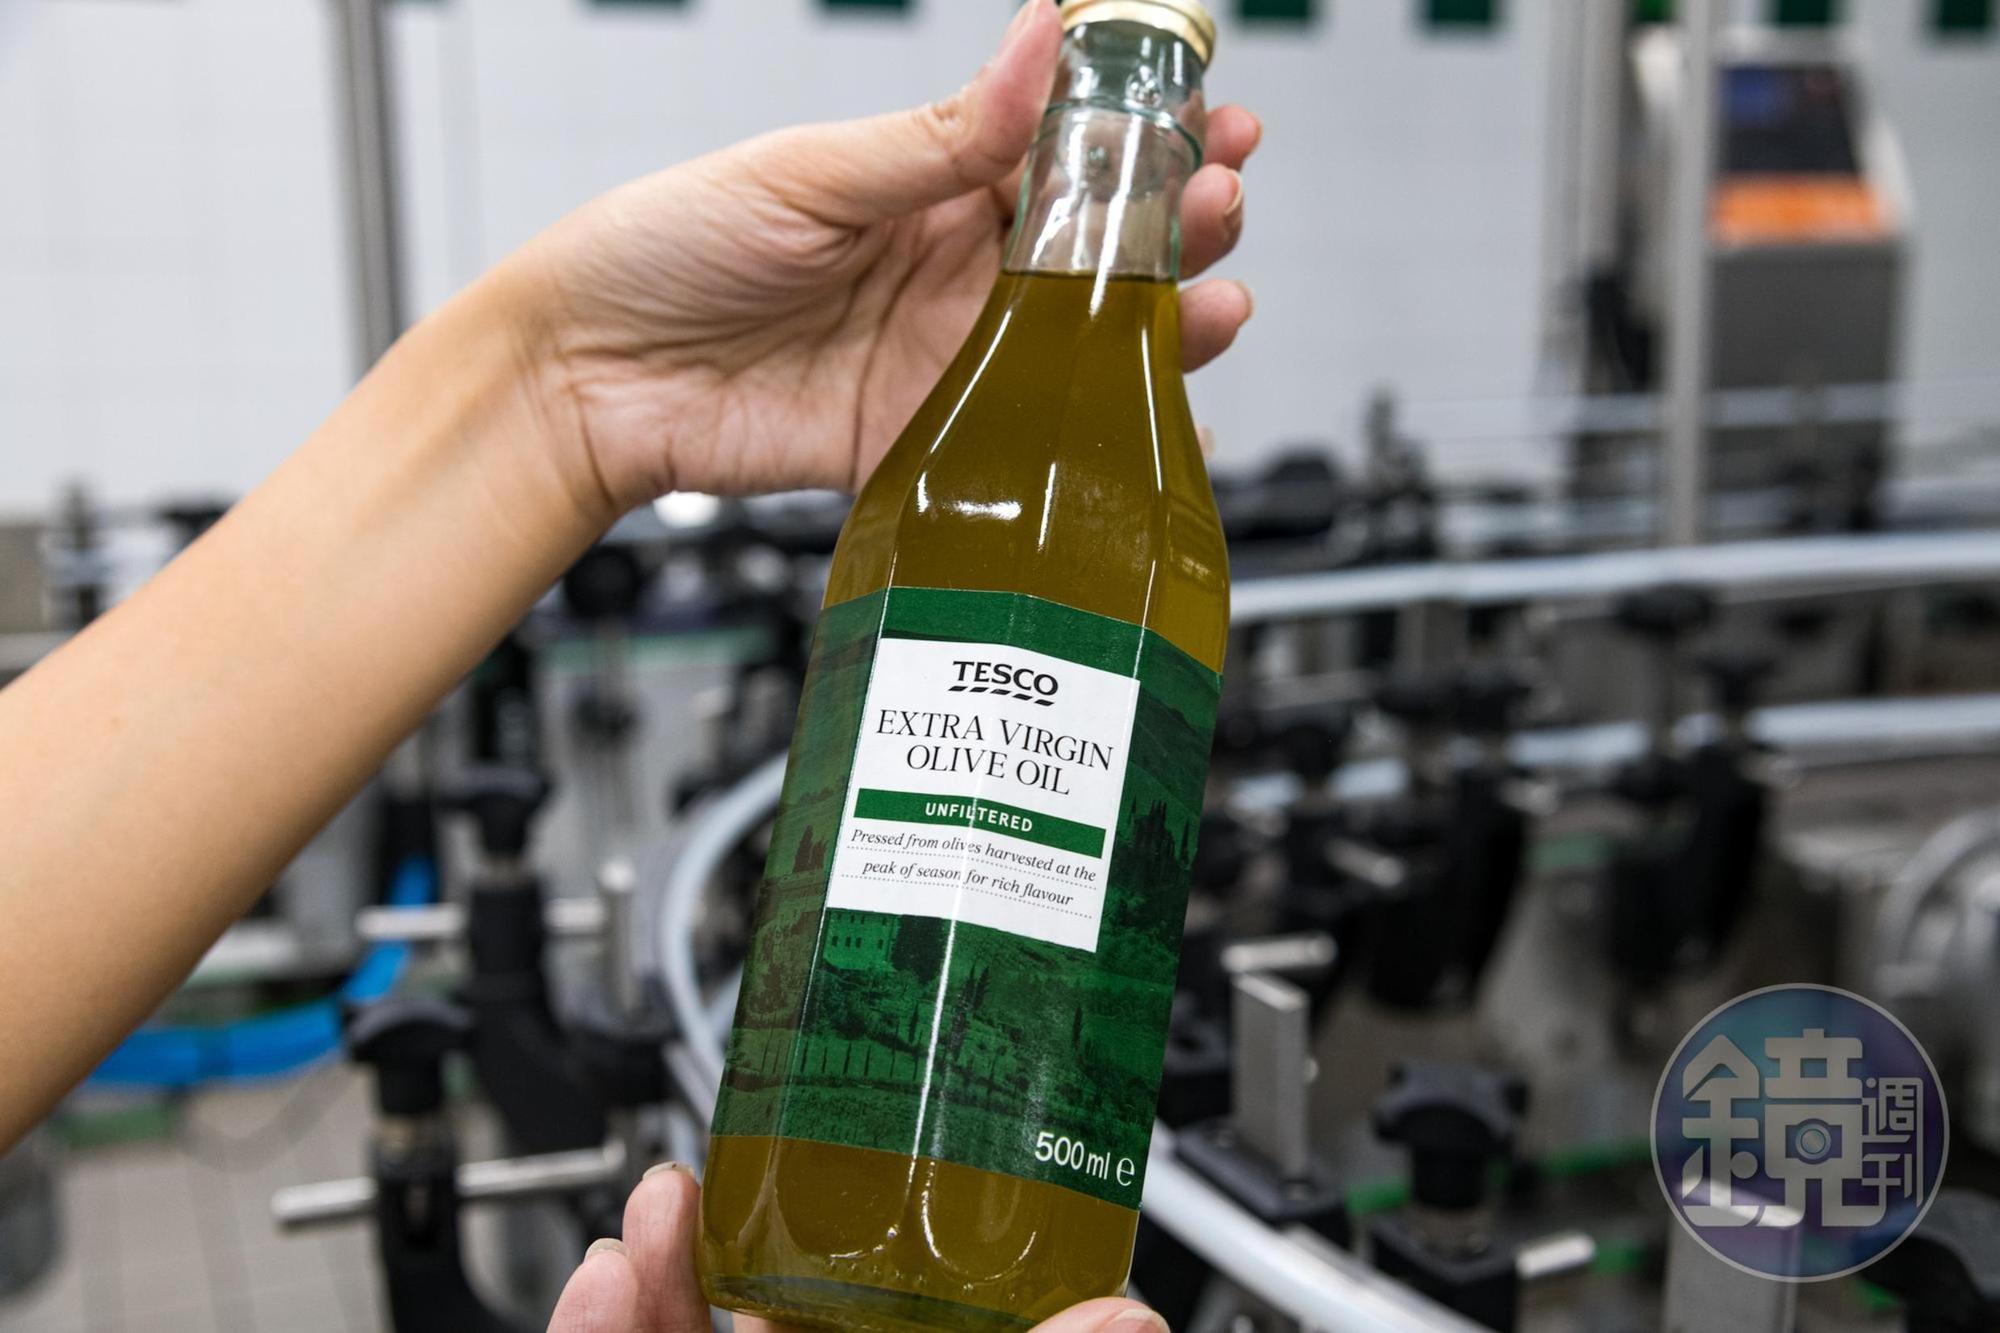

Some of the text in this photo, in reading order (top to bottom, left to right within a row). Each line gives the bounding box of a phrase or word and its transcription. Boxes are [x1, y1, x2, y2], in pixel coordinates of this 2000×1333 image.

[953, 661, 1059, 696] TESCO
[876, 709, 1114, 771] EXTRA VIRGIN
[906, 744, 1070, 795] OLIVE OIL
[924, 802, 1033, 832] UNFILTERED
[851, 829, 1097, 882] Pressed from olives harvested at the
[862, 861, 1075, 905] peak of season for rich flavour
